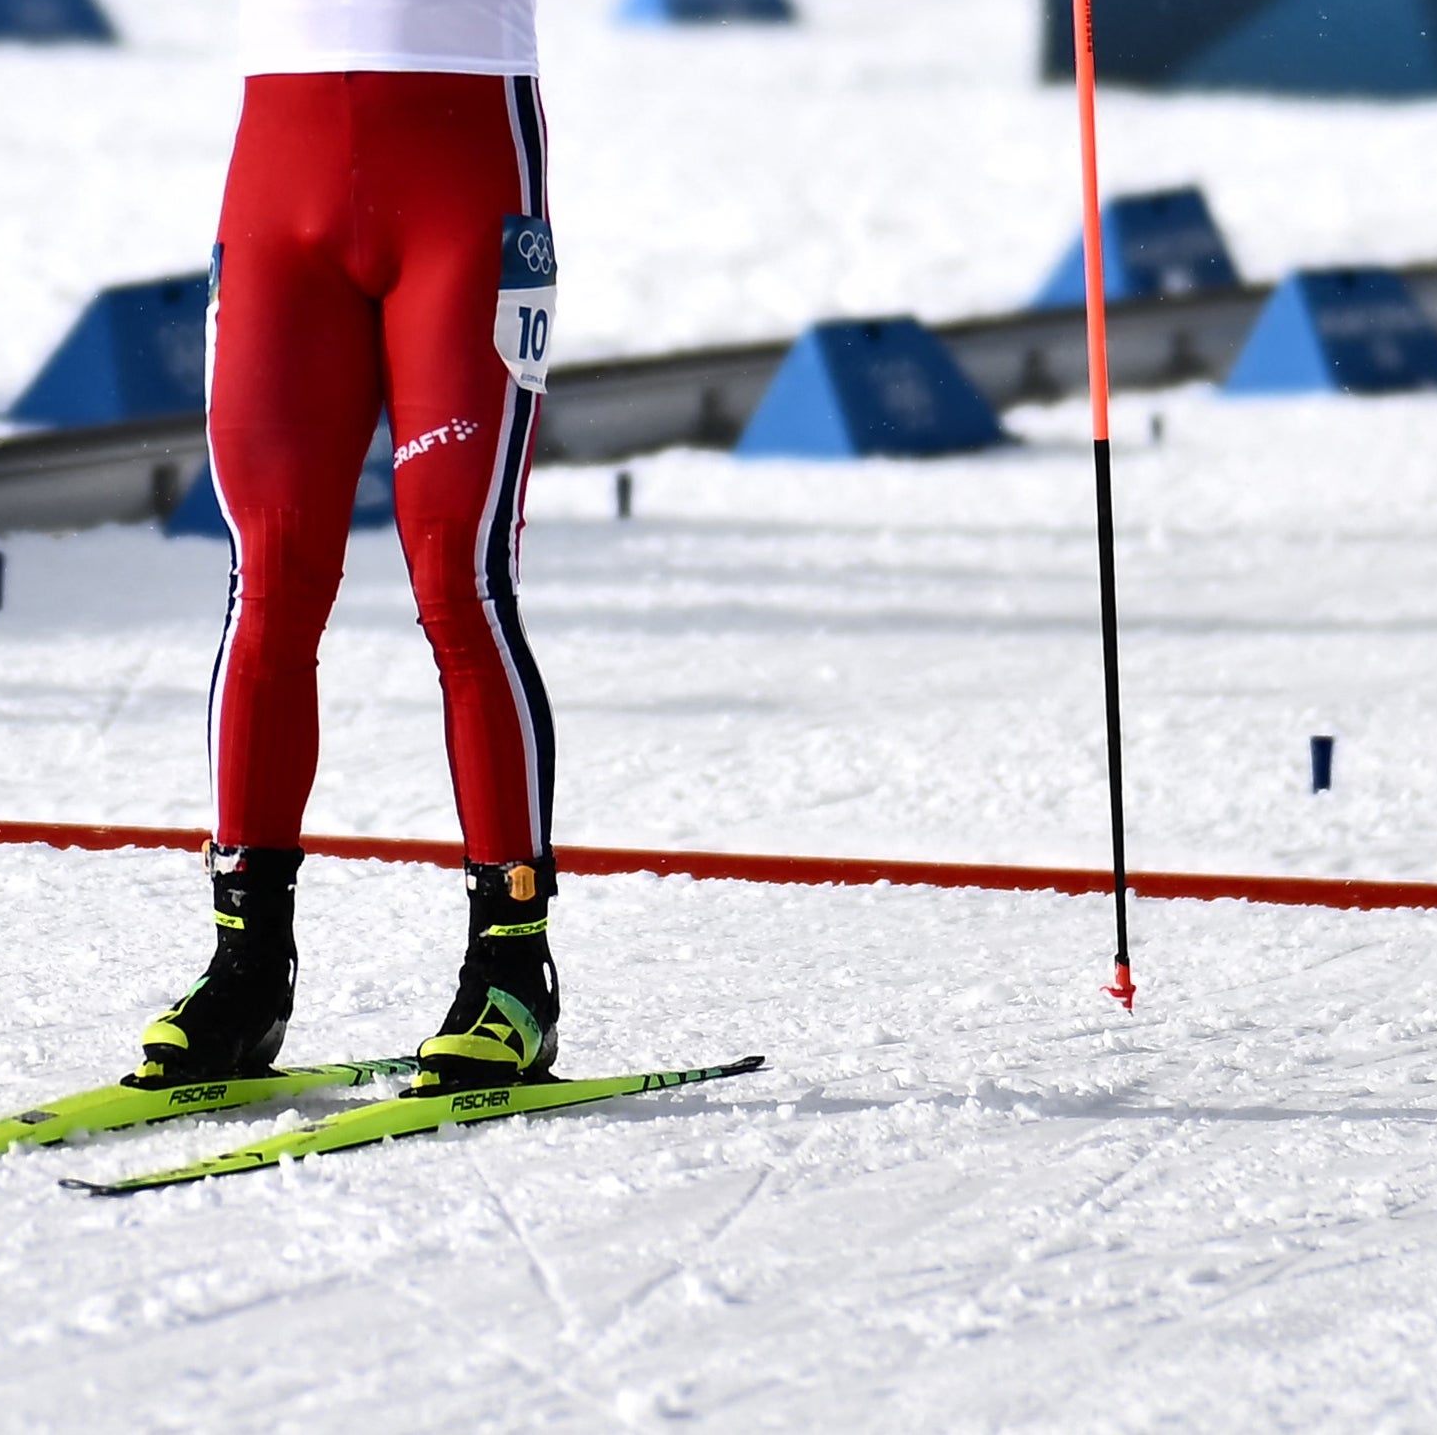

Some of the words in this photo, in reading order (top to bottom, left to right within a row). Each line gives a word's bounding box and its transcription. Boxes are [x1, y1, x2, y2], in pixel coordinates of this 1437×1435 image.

[518, 306, 548, 361] 10
[168, 1084, 228, 1106] FISCHER
[451, 1090, 510, 1113] FISCHER
